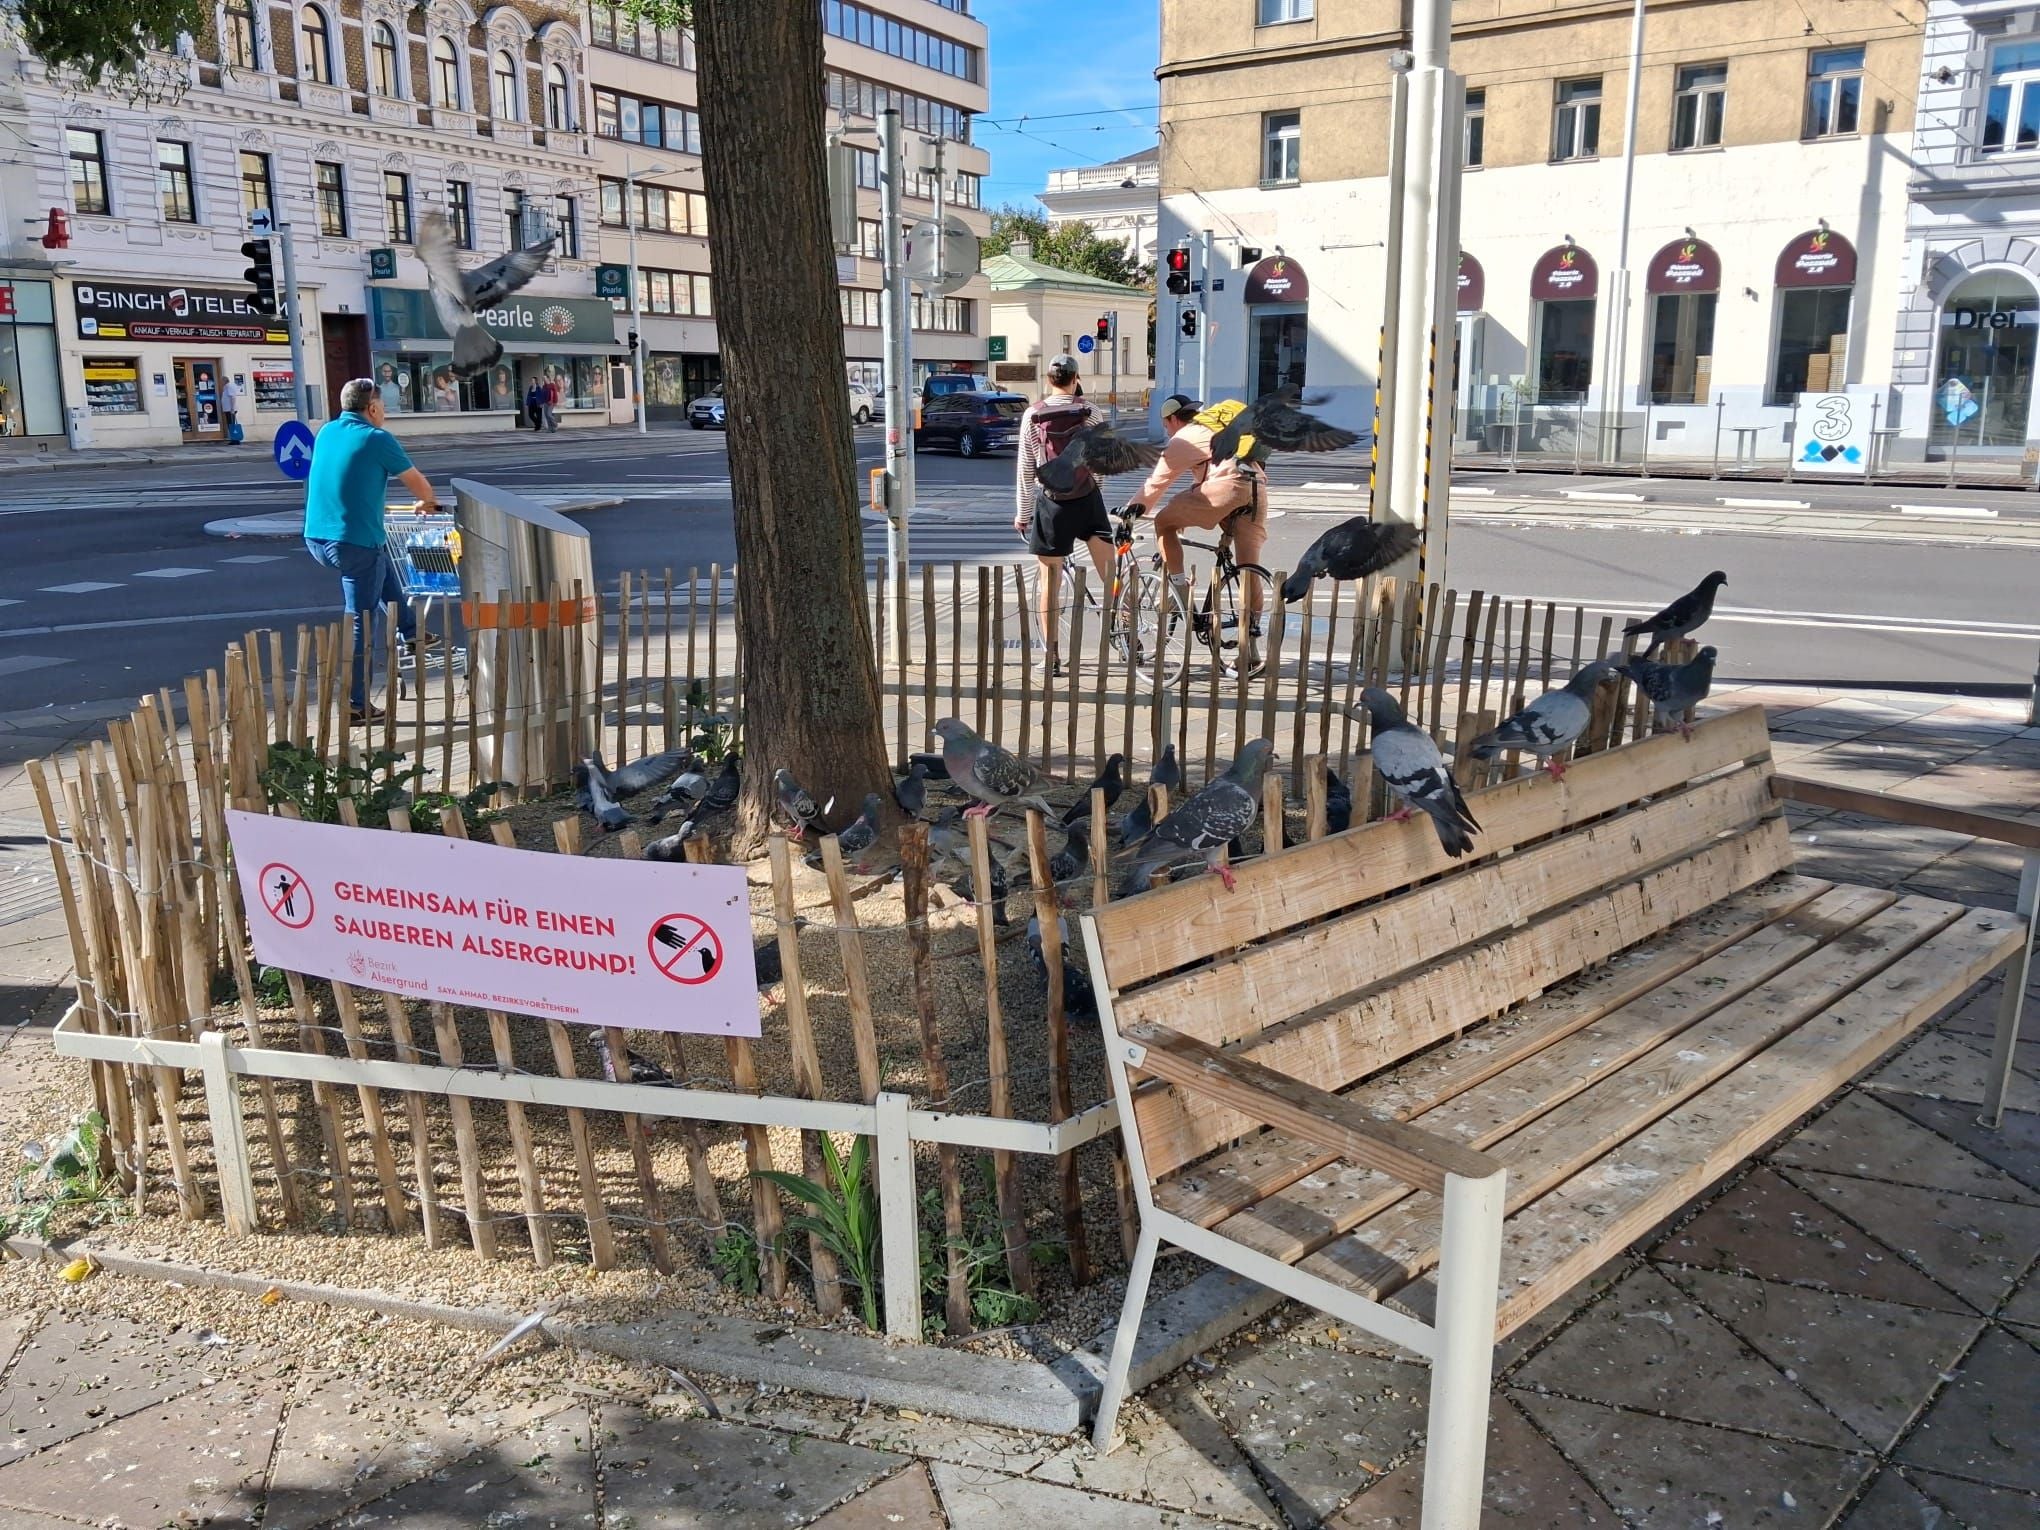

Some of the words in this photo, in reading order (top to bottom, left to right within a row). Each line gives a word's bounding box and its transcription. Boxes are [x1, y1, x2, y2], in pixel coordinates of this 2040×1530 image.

[602, 286, 622, 294] Pearle
[96, 291, 165, 311] SINGH
[134, 327, 160, 335] ANKAUF
[165, 328, 195, 336] VERKAUF
[199, 329, 223, 337] TAUSCH
[226, 330, 261, 338] REPARATUR
[334, 881, 478, 918] GEMEINSAM
[485, 898, 528, 927] FÜR
[536, 910, 615, 937] EINEN
[334, 914, 453, 949] SAUBEREN
[461, 933, 636, 975] ALSERGRUND!
[368, 957, 398, 973] Bezirk
[371, 971, 428, 990] Alsergrund
[437, 986, 457, 995] SAYA
[460, 988, 491, 1001] AHMAD,
[492, 994, 579, 1014] BEZIRKSVORSTEHERIN
